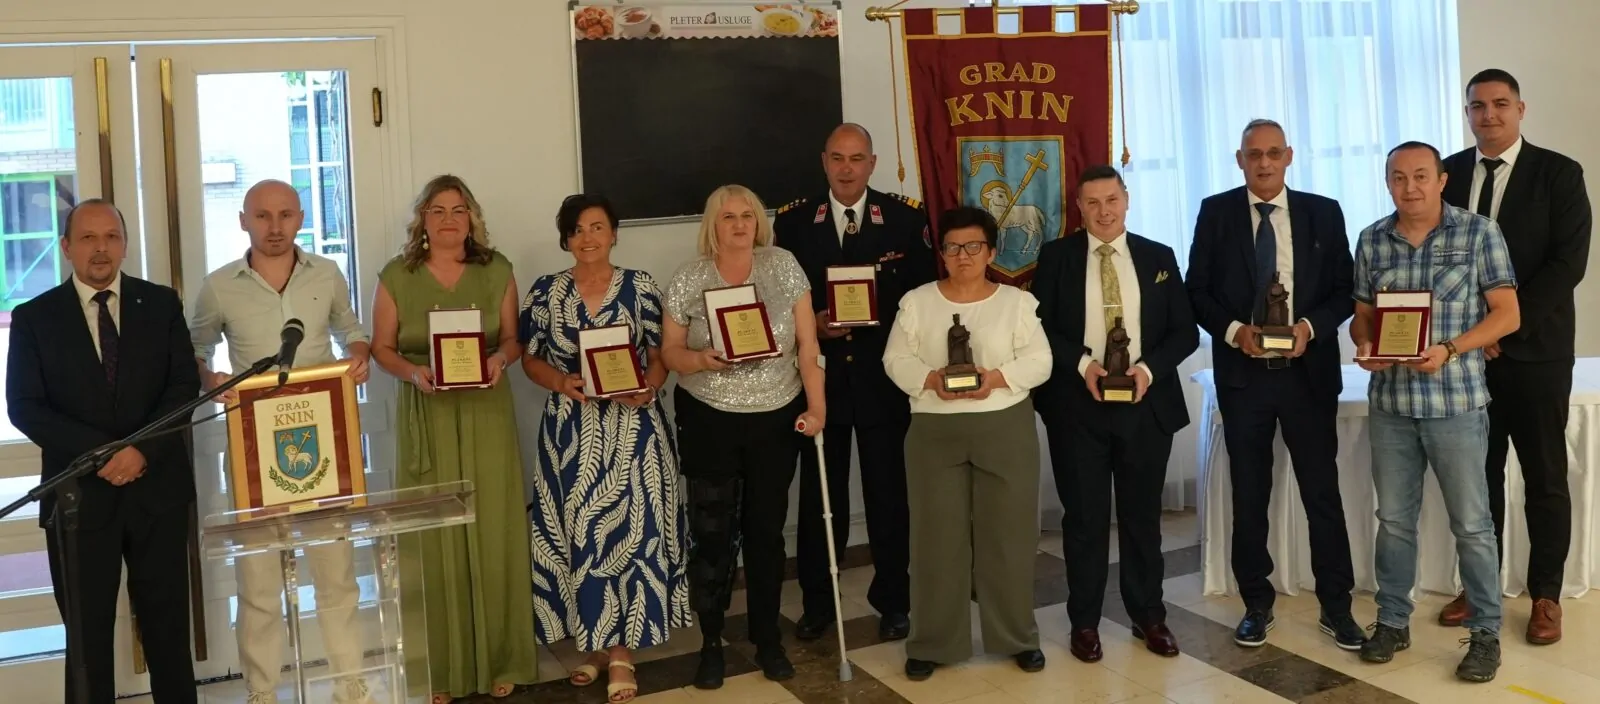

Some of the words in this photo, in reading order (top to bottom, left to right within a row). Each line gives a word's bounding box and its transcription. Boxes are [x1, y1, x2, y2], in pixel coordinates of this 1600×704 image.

[671, 16, 703, 25] PLETER
[718, 16, 752, 25] USLUGE
[959, 62, 1056, 86] GRAD
[944, 90, 1073, 127] KNIN
[276, 400, 310, 412] GRAD
[274, 410, 314, 426] KNIN
